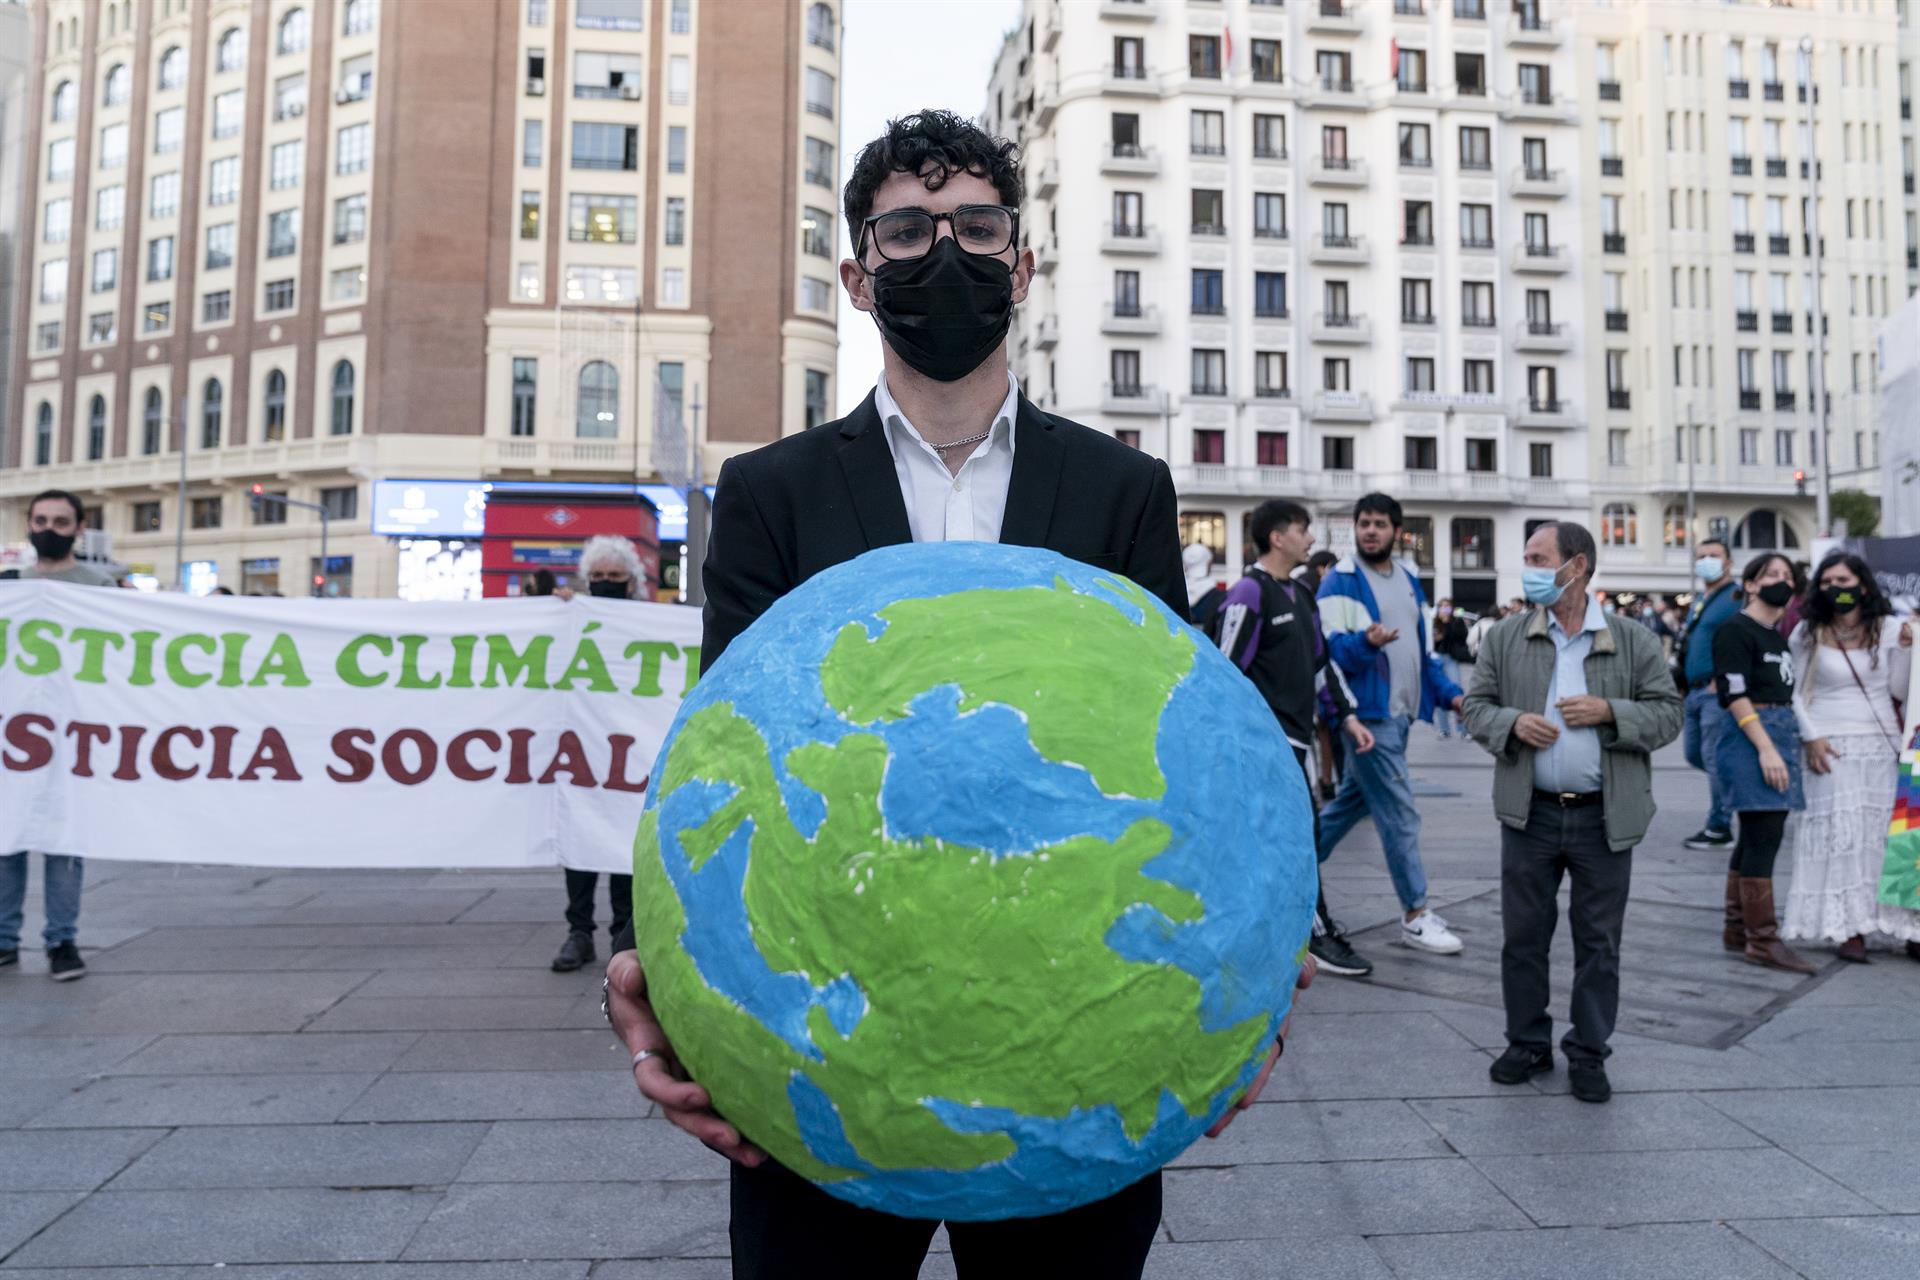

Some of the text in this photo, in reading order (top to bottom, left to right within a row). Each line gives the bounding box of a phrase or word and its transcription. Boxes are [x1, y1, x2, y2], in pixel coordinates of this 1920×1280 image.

[0, 619, 311, 688] STICIA
[0, 713, 649, 793] STICIA SOCIAL
